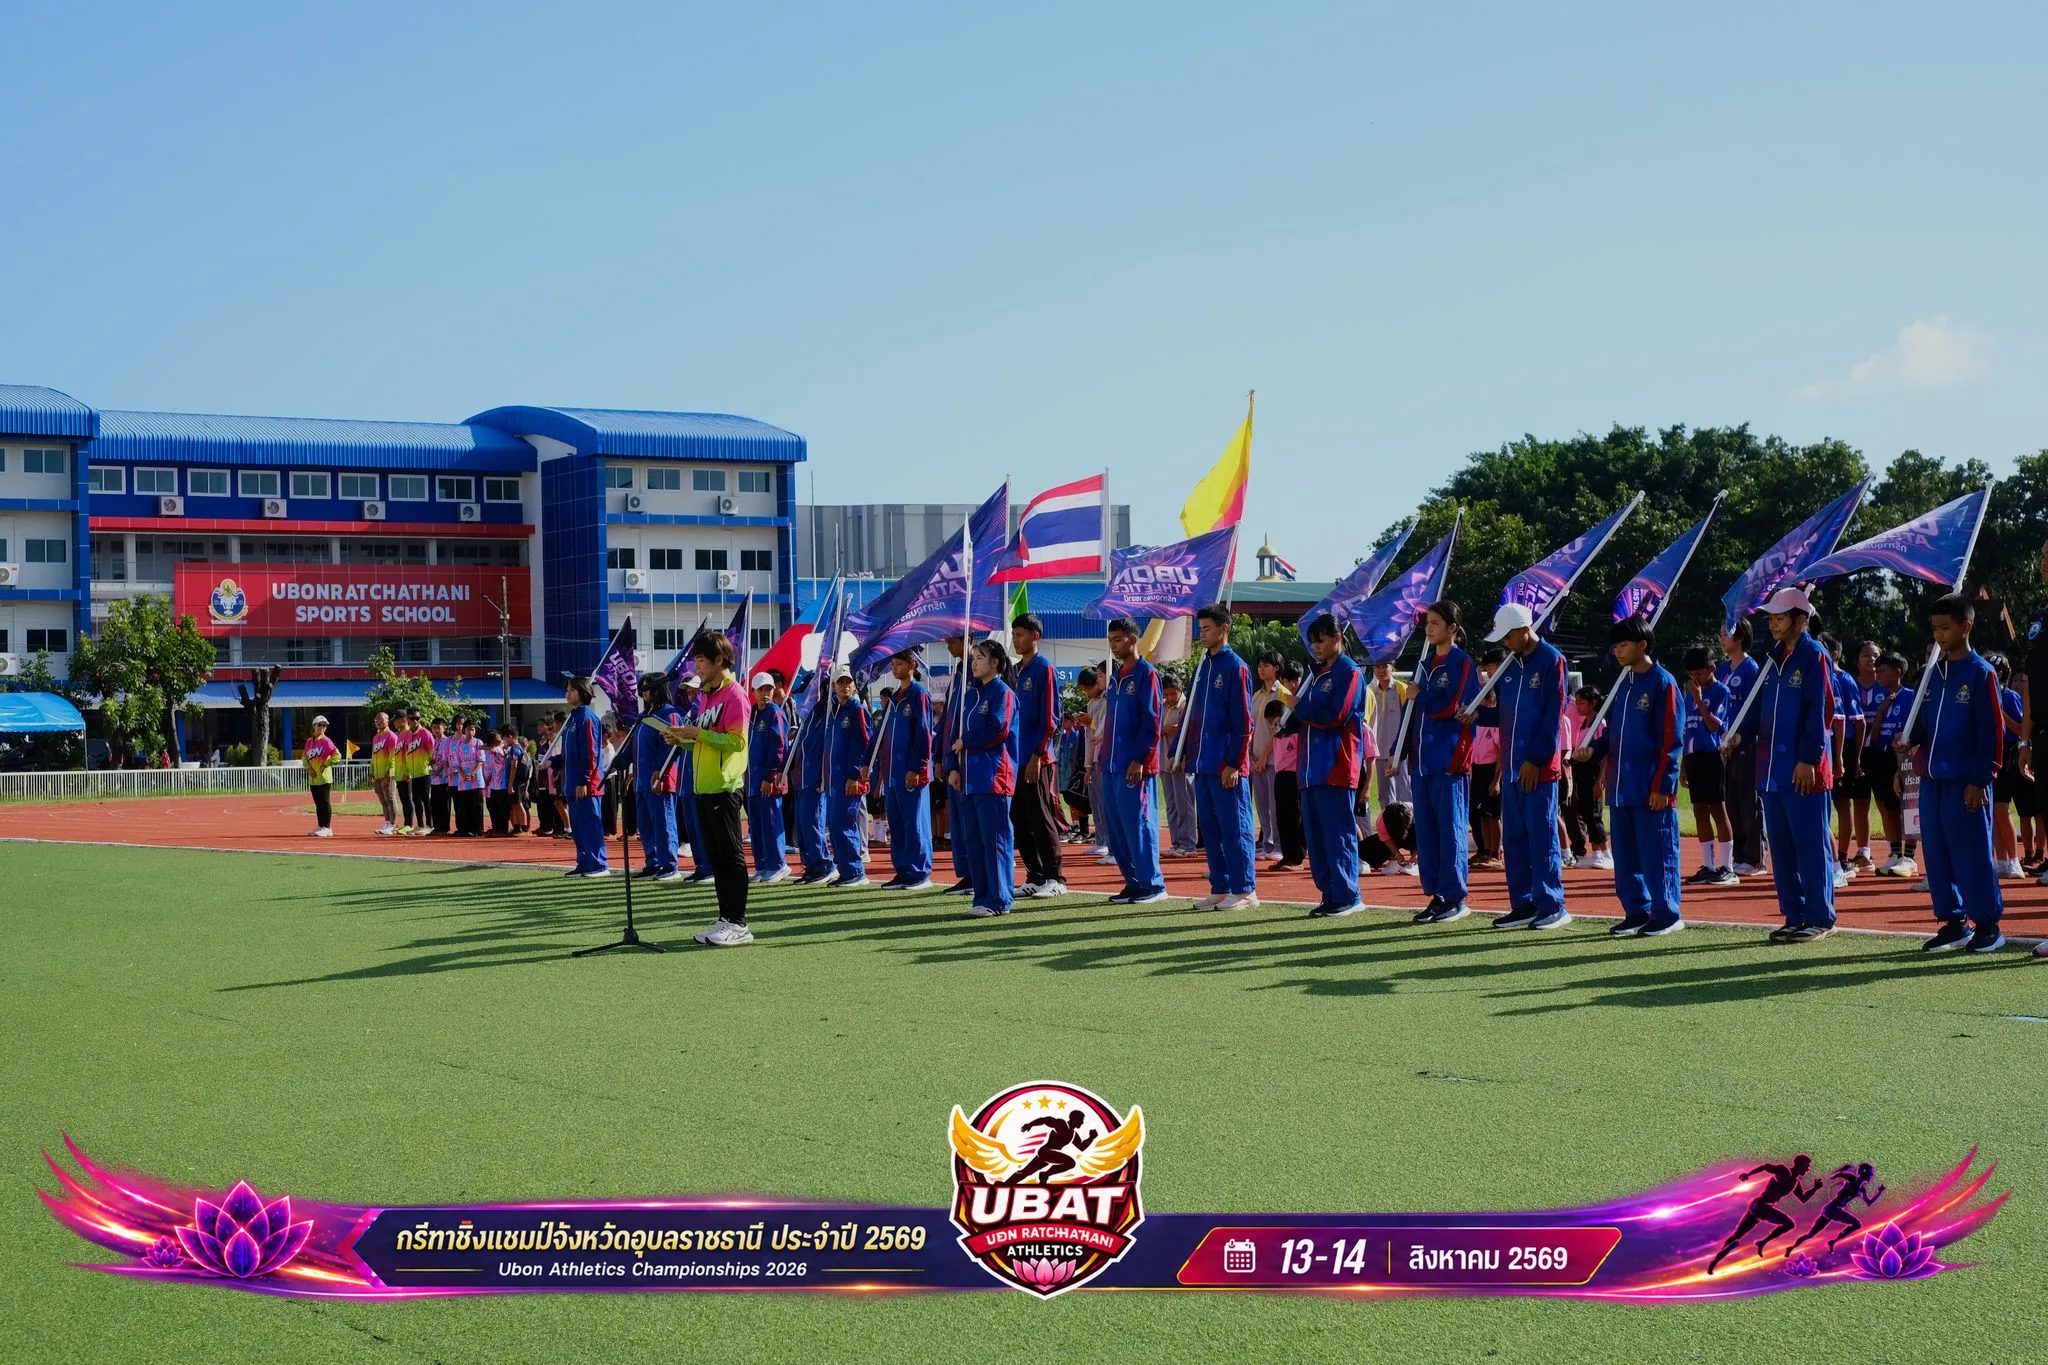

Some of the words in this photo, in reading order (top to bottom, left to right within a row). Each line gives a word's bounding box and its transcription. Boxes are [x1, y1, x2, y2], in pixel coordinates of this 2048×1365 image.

[272, 582, 470, 601] UBONRATCHATHANI
[296, 605, 370, 623] SPORTS
[382, 605, 456, 623] SCHOOL
